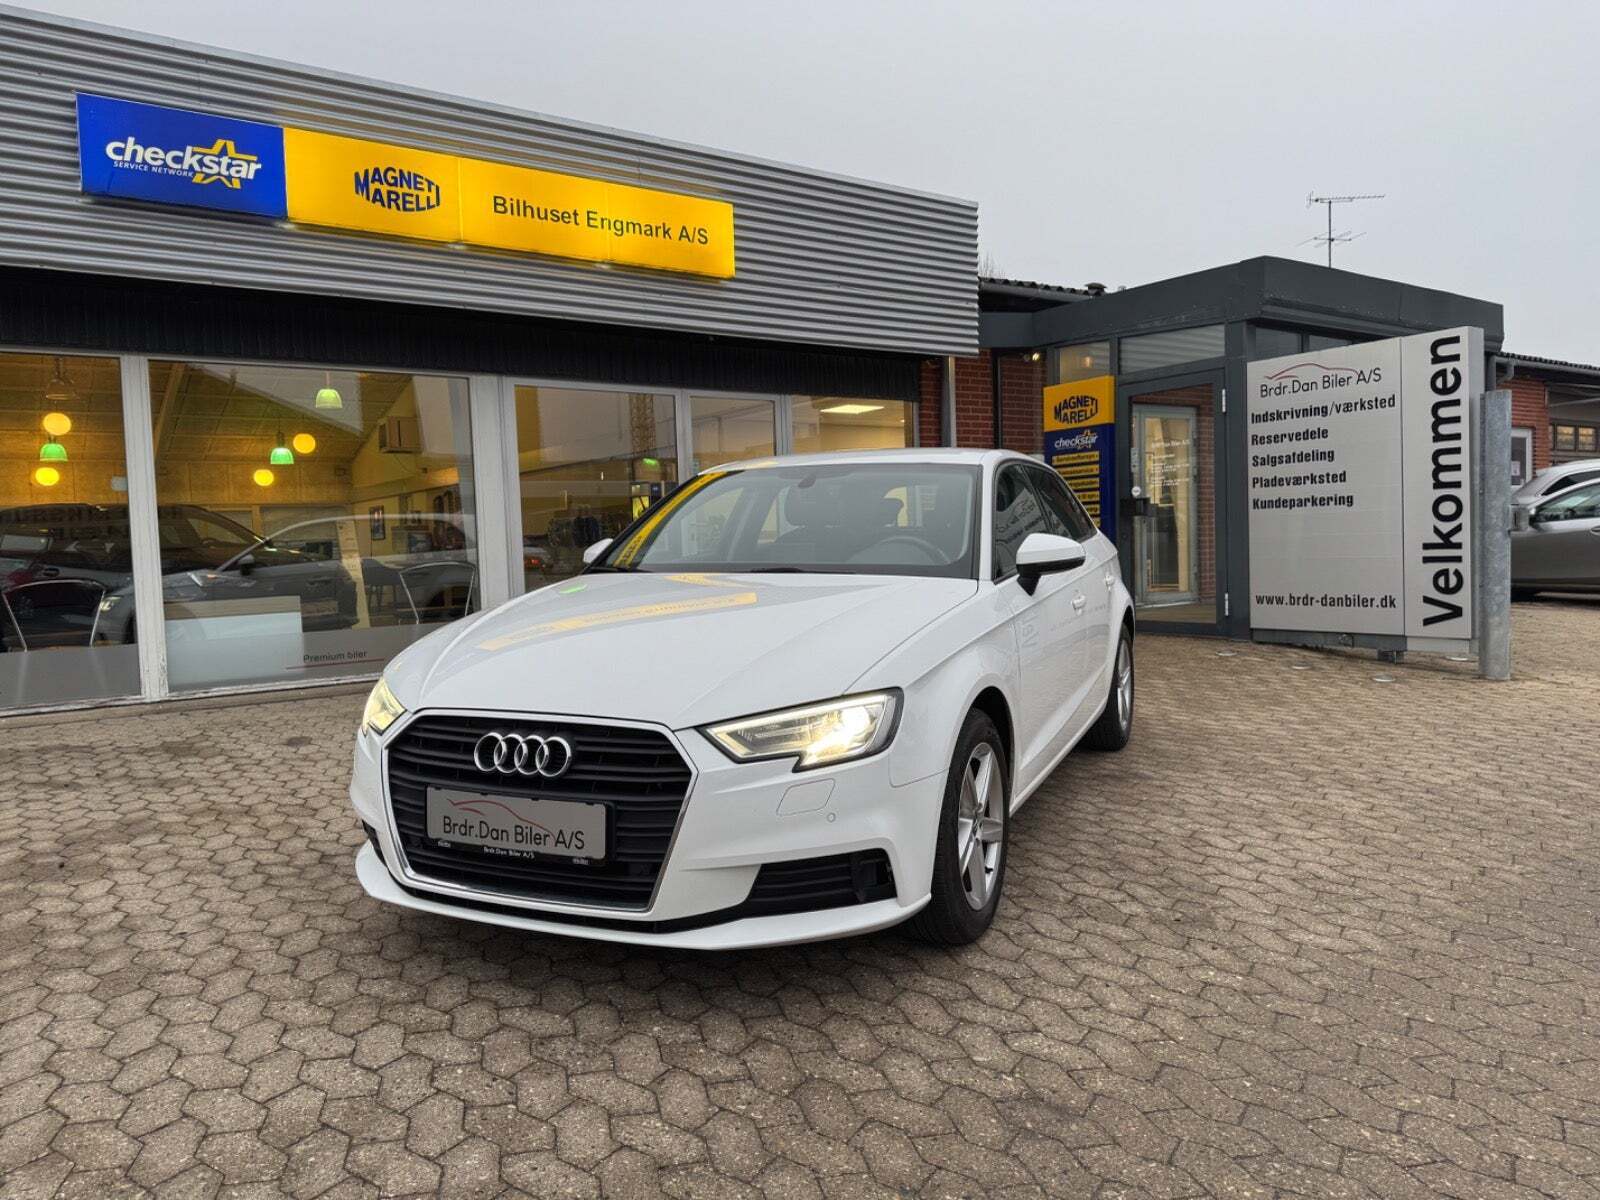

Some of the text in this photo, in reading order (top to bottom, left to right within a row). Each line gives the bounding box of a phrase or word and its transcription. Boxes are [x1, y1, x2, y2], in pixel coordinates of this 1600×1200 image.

[105, 136, 262, 180] checkstar
[113, 161, 194, 178] SERVICE NETWORK
[354, 167, 441, 201] MAGNETI
[354, 180, 441, 212] MARELLI
[492, 195, 709, 245] Bilhuset Engmark A/S
[1322, 374, 1352, 391] Biler
[1356, 367, 1382, 386] A/S
[1251, 394, 1396, 424] Indskrivning/værksted
[1251, 427, 1329, 446] Reservedele
[1252, 449, 1335, 468] Salgsafdeling
[1252, 470, 1347, 489] Pladeværksted
[1422, 334, 1464, 626] Velkommen
[1252, 493, 1354, 511] Kundeparkering
[1255, 592, 1397, 609] www.brdr-danbiler.dk
[304, 650, 368, 662] Premium biler
[514, 824, 550, 846] Biler
[554, 829, 585, 850] A/S
